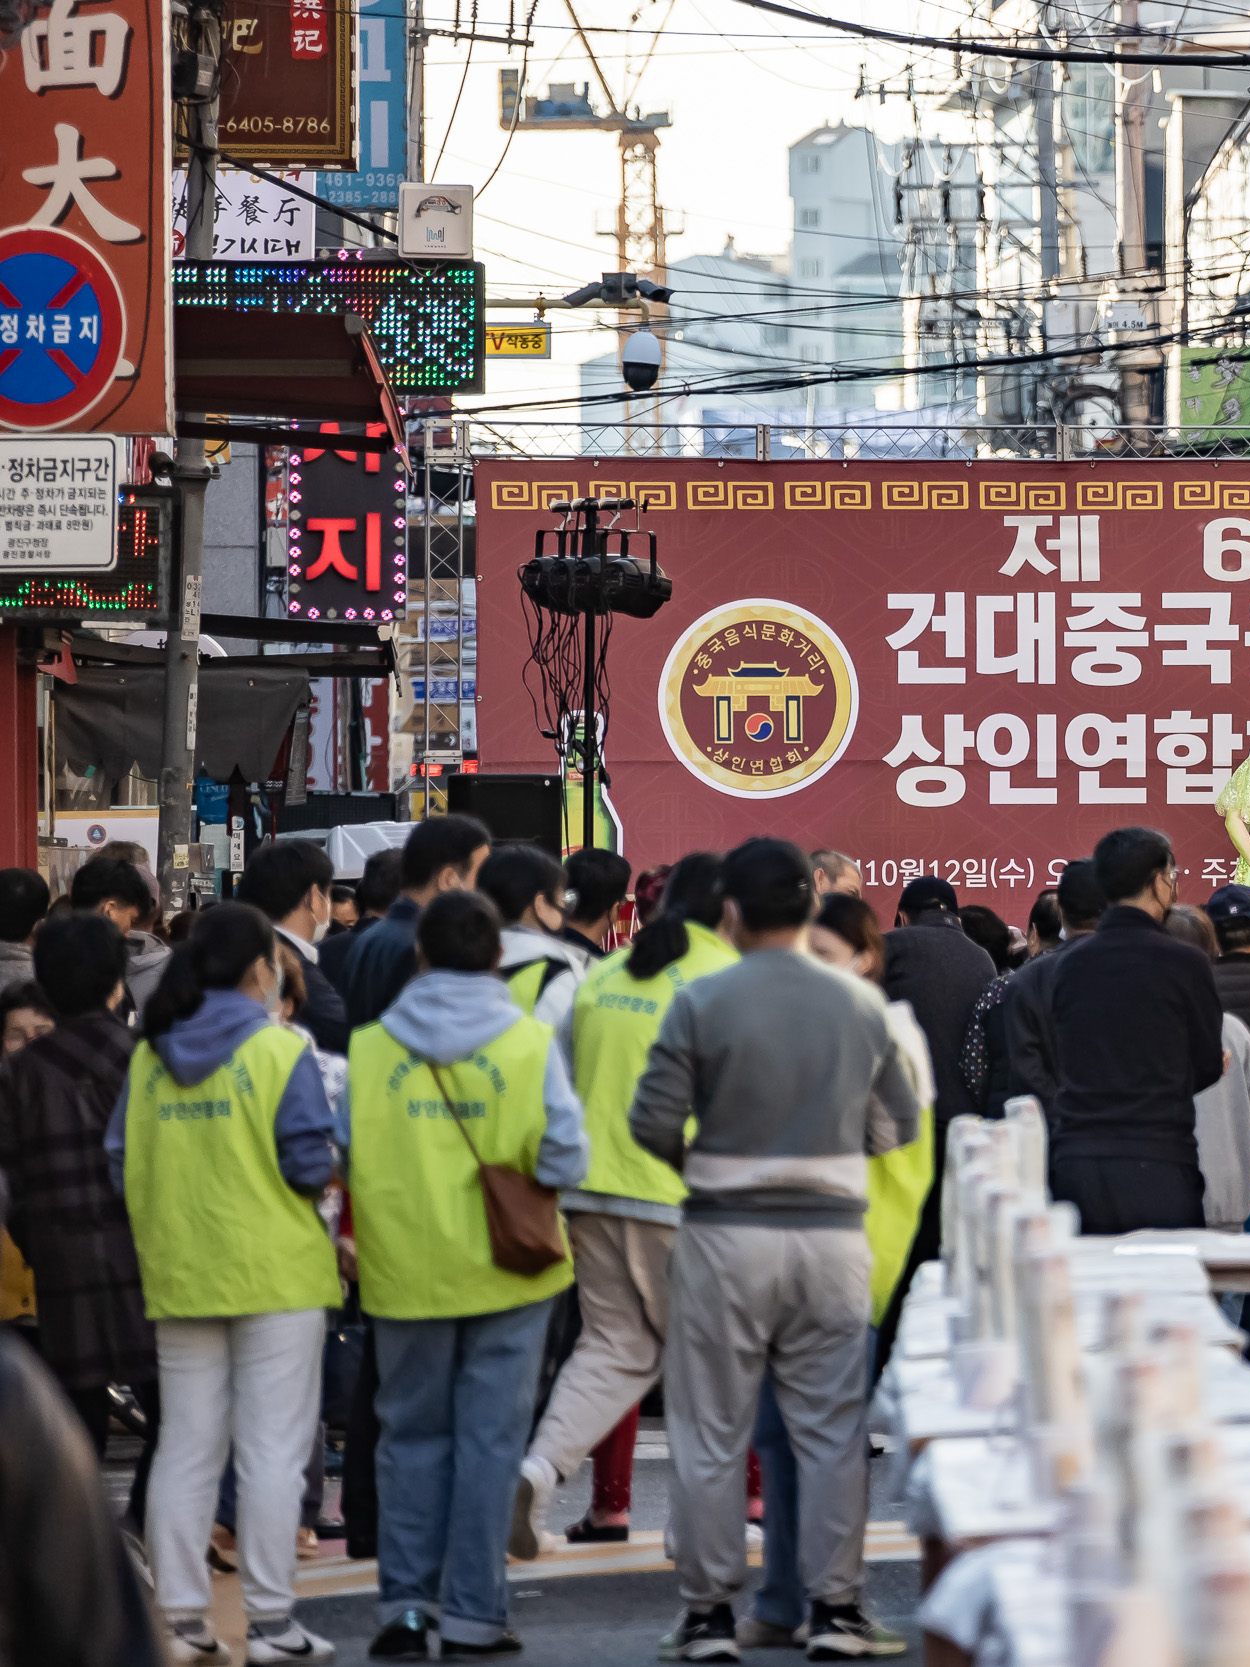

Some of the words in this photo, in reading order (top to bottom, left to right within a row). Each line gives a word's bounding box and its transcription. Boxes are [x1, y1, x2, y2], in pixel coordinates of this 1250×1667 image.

[68, 488, 107, 500] 금지되는
[998, 514, 1101, 583] 제
[694, 623, 825, 671] 중국음식문화거리
[712, 748, 804, 775] 상인연합회
[856, 857, 1035, 889] 10월12일(수)
